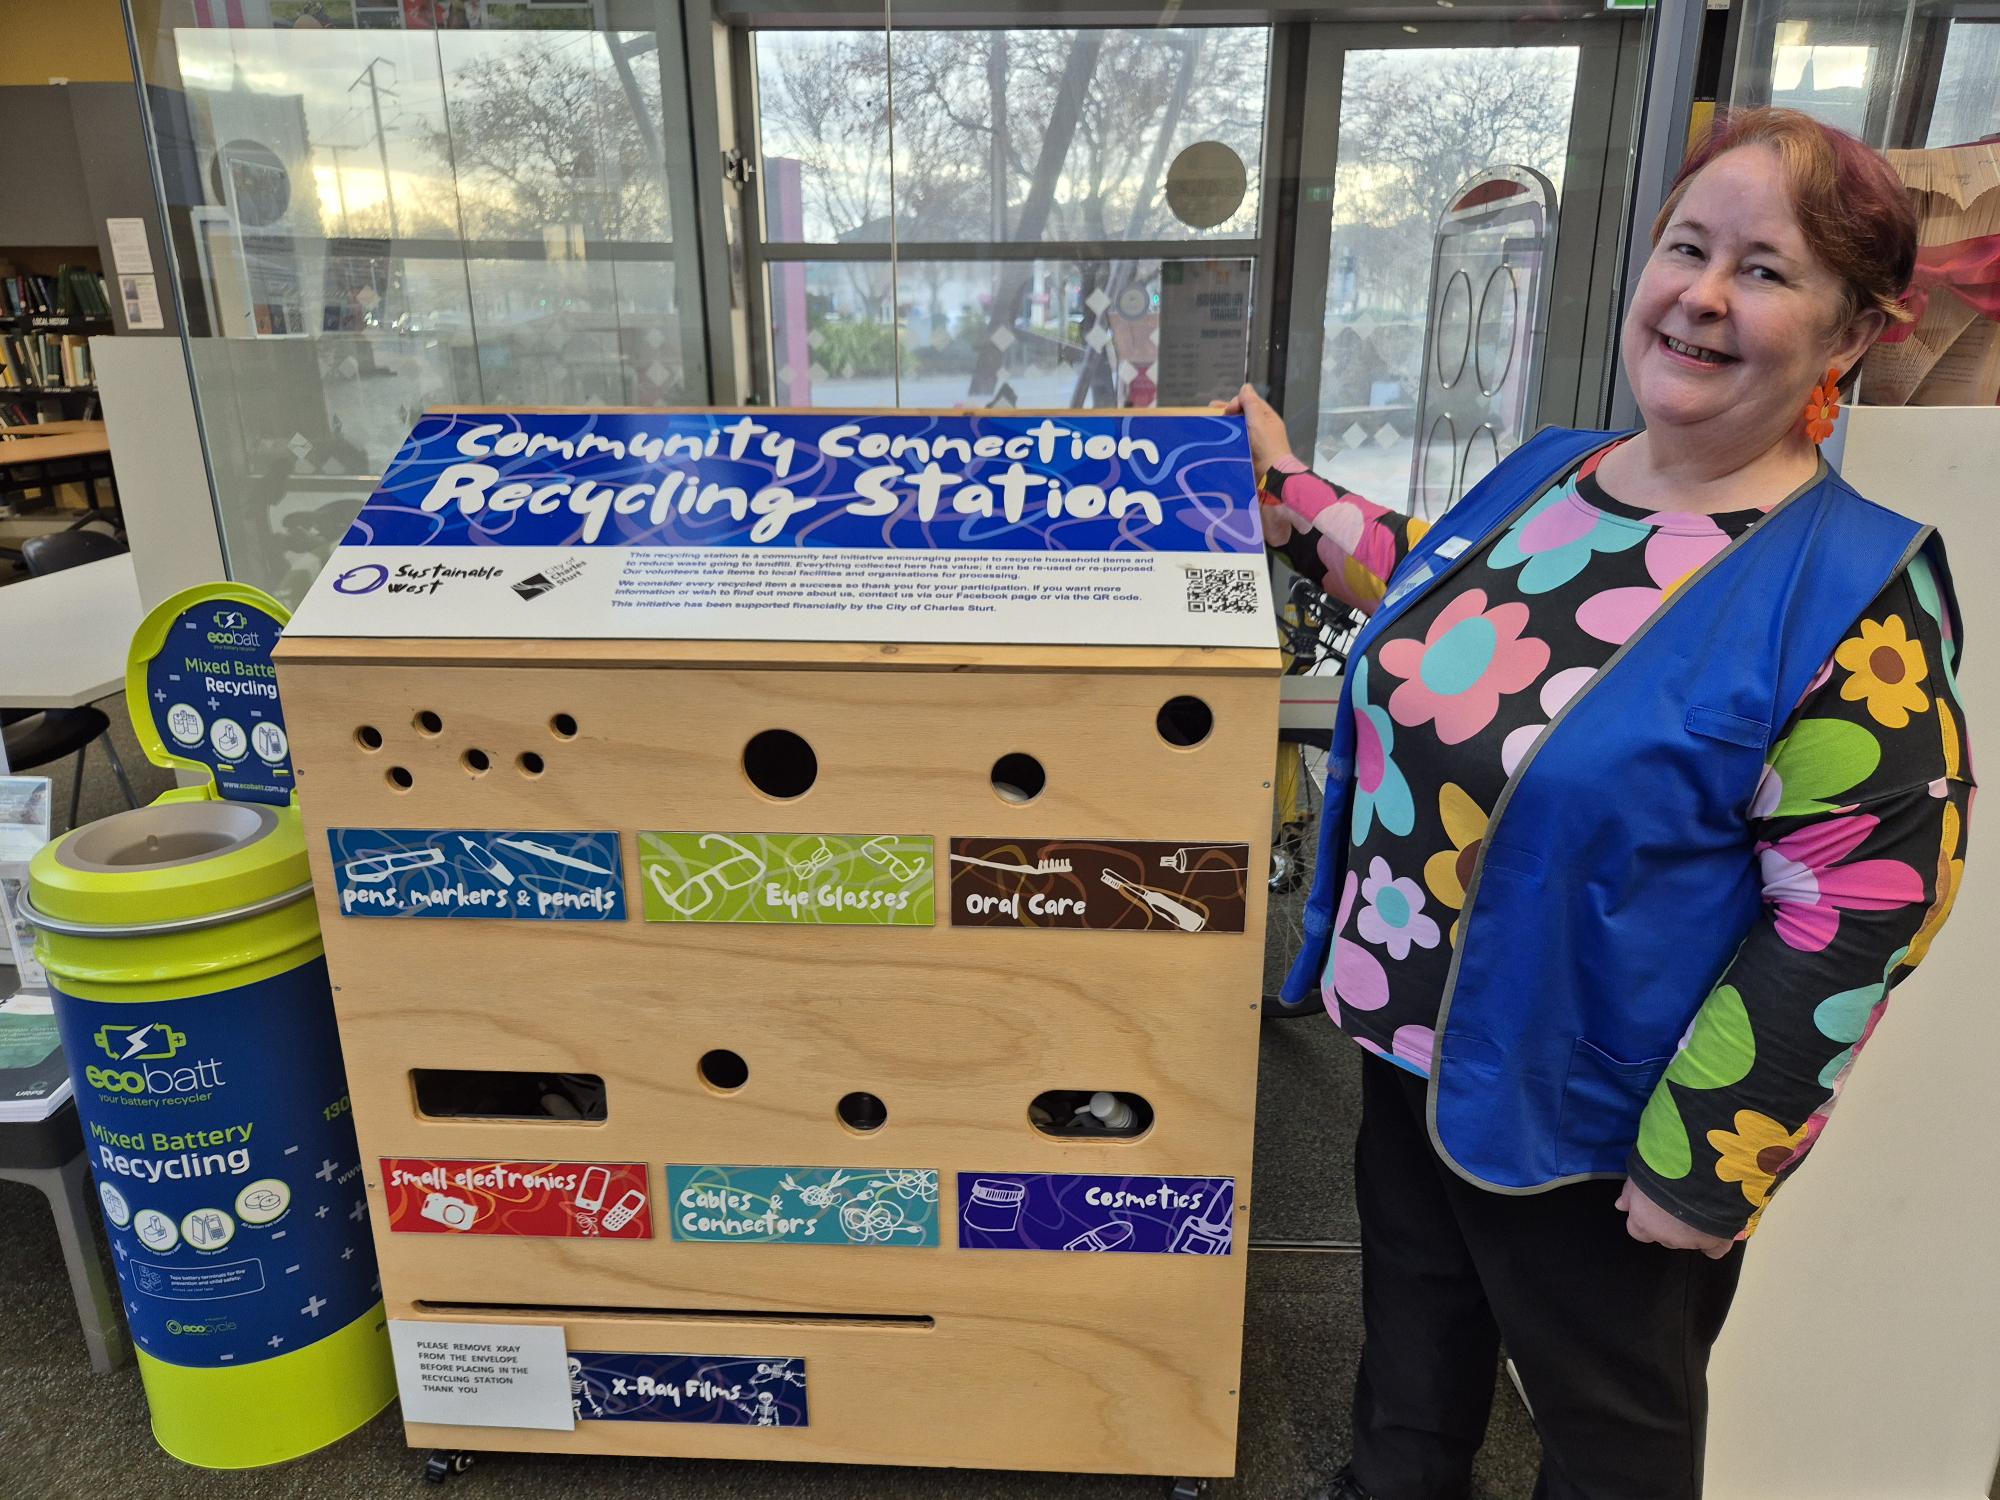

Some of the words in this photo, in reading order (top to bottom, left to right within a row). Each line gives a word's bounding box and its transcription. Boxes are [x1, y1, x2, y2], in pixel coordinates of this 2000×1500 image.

[457, 417, 795, 478] Community
[819, 419, 1159, 464] Connection
[421, 463, 817, 543] Recycling
[846, 462, 1163, 525] Station
[626, 559, 635, 567] to
[709, 560, 738, 569] going
[741, 560, 751, 568] to
[795, 561, 851, 570] Everything
[929, 562, 948, 570] has
[1032, 563, 1072, 571] re-used
[1088, 564, 1155, 573] re-purposed.
[630, 551, 650, 559] This
[653, 552, 700, 560] recycling
[740, 552, 749, 560] is
[761, 553, 818, 562] community
[886, 554, 951, 563] encouraging
[954, 555, 988, 563] people
[1005, 555, 1041, 564] recycle
[395, 563, 503, 579] Sustainable
[644, 568, 698, 576] volunteers
[771, 569, 795, 577] local
[867, 571, 938, 579] organisations
[959, 571, 1019, 580] processing.
[619, 579, 633, 587] We
[685, 581, 713, 589] every
[716, 581, 761, 589] recycled
[933, 584, 957, 592] your
[960, 583, 1029, 592] participation.
[1042, 585, 1062, 593] you
[719, 589, 729, 597] to
[1011, 593, 1037, 601] page
[611, 600, 632, 608] This
[705, 601, 731, 609] been
[734, 602, 788, 611] supported
[792, 602, 846, 611] financially
[849, 603, 862, 612] by
[885, 603, 906, 612] City
[909, 603, 920, 611] of
[207, 630, 261, 647] ecobatt
[184, 656, 230, 675] Mixed
[205, 677, 277, 699] Recycling
[223, 781, 288, 793] www.ecobatt.com.au
[343, 887, 404, 913] pens,
[411, 883, 508, 908] markers
[517, 890, 530, 906] &
[538, 886, 616, 915] pencils
[766, 883, 809, 919] Eye
[817, 885, 910, 911] Glasses
[966, 892, 1020, 920] Oral
[1028, 893, 1087, 916] Care
[85, 1058, 226, 1094] ecobatt
[99, 1094, 118, 1104] your
[120, 1096, 159, 1107] battery
[162, 1093, 212, 1105] recycler
[89, 1121, 145, 1151] Mixed
[152, 1122, 253, 1151] Battery
[99, 1146, 250, 1183] Recycling
[391, 1167, 448, 1190] small
[455, 1165, 577, 1191] electronics
[680, 1189, 753, 1214] Cables
[770, 1194, 784, 1210] &
[1085, 1183, 1204, 1210] Cosmetics
[682, 1209, 818, 1235] Connectors
[183, 1321, 237, 1334] ecocycle
[417, 1341, 448, 1350] PLEASE
[453, 1343, 492, 1352] REMOVE
[496, 1344, 520, 1352] XRAY
[419, 1352, 445, 1361] FROM
[450, 1354, 467, 1362] THE
[472, 1355, 518, 1363] ENVELOPE
[420, 1363, 454, 1372] BEFORE
[456, 1365, 494, 1373] PLACING
[499, 1366, 509, 1374] IN
[511, 1367, 528, 1375] THE
[422, 1374, 469, 1383] RECYCLING
[474, 1376, 513, 1384] STATION
[424, 1385, 454, 1393] THANK
[458, 1386, 478, 1394] YOU
[685, 1379, 741, 1401] Films
